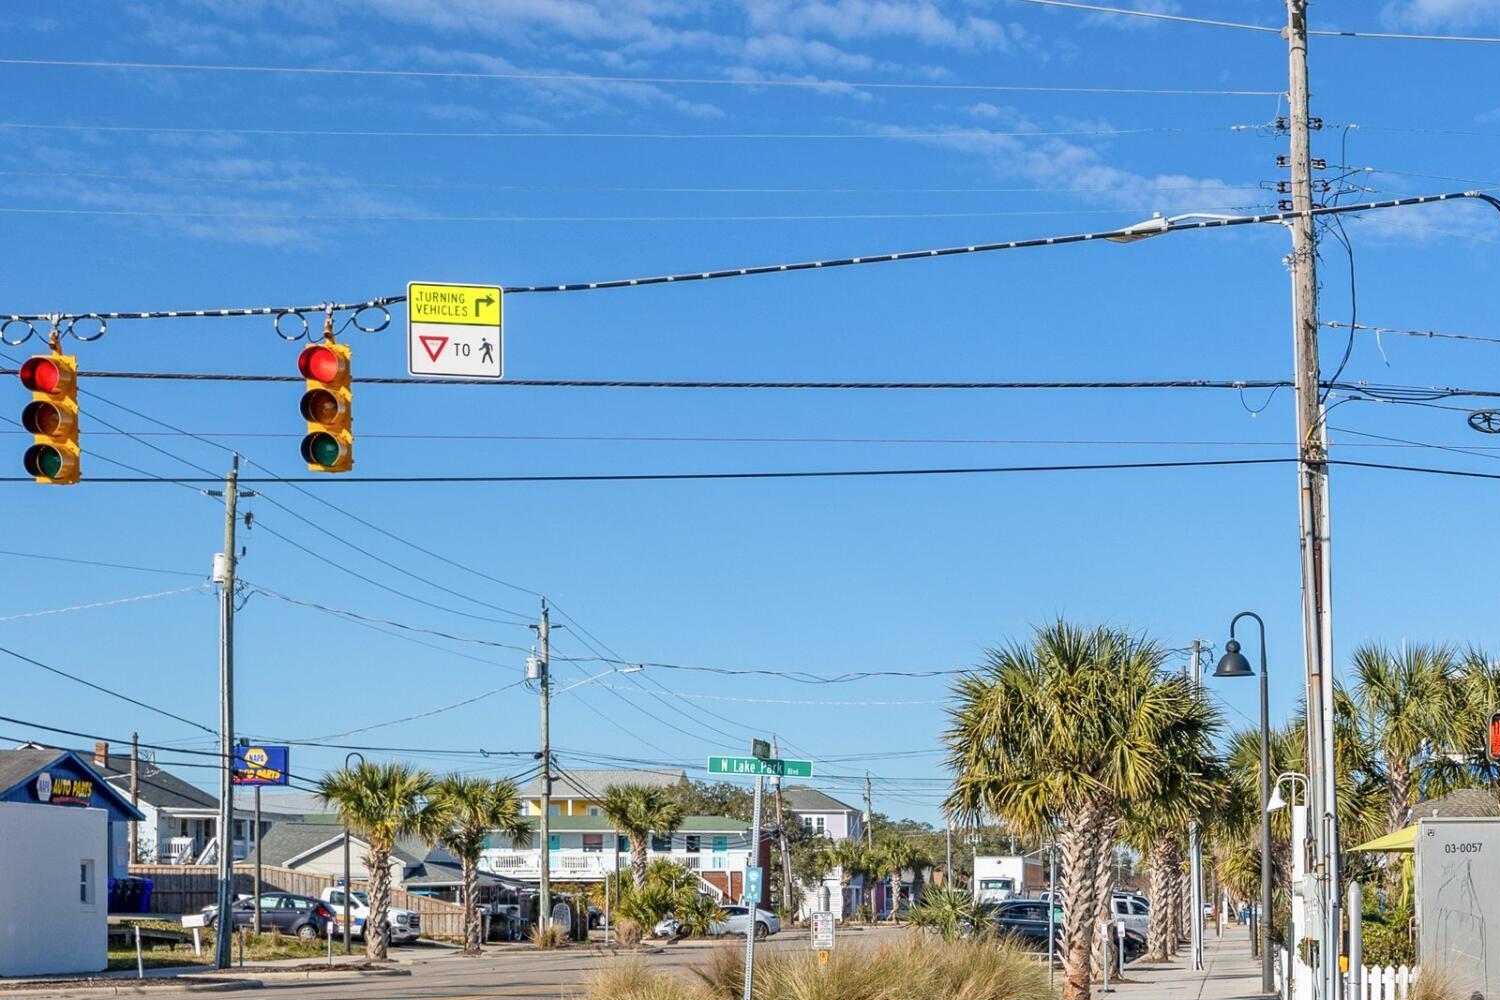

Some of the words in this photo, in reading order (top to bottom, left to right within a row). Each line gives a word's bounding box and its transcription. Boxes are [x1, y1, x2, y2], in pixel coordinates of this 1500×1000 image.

[418, 291, 466, 304] TURNING
[415, 304, 468, 317] VEHICLES
[453, 343, 471, 357] TO
[721, 759, 728, 772] N
[733, 760, 756, 773] Lake
[760, 761, 783, 775] Park
[52, 778, 72, 796] AUTO
[72, 780, 93, 798] PARTS
[1444, 843, 1483, 854] 03-0057
